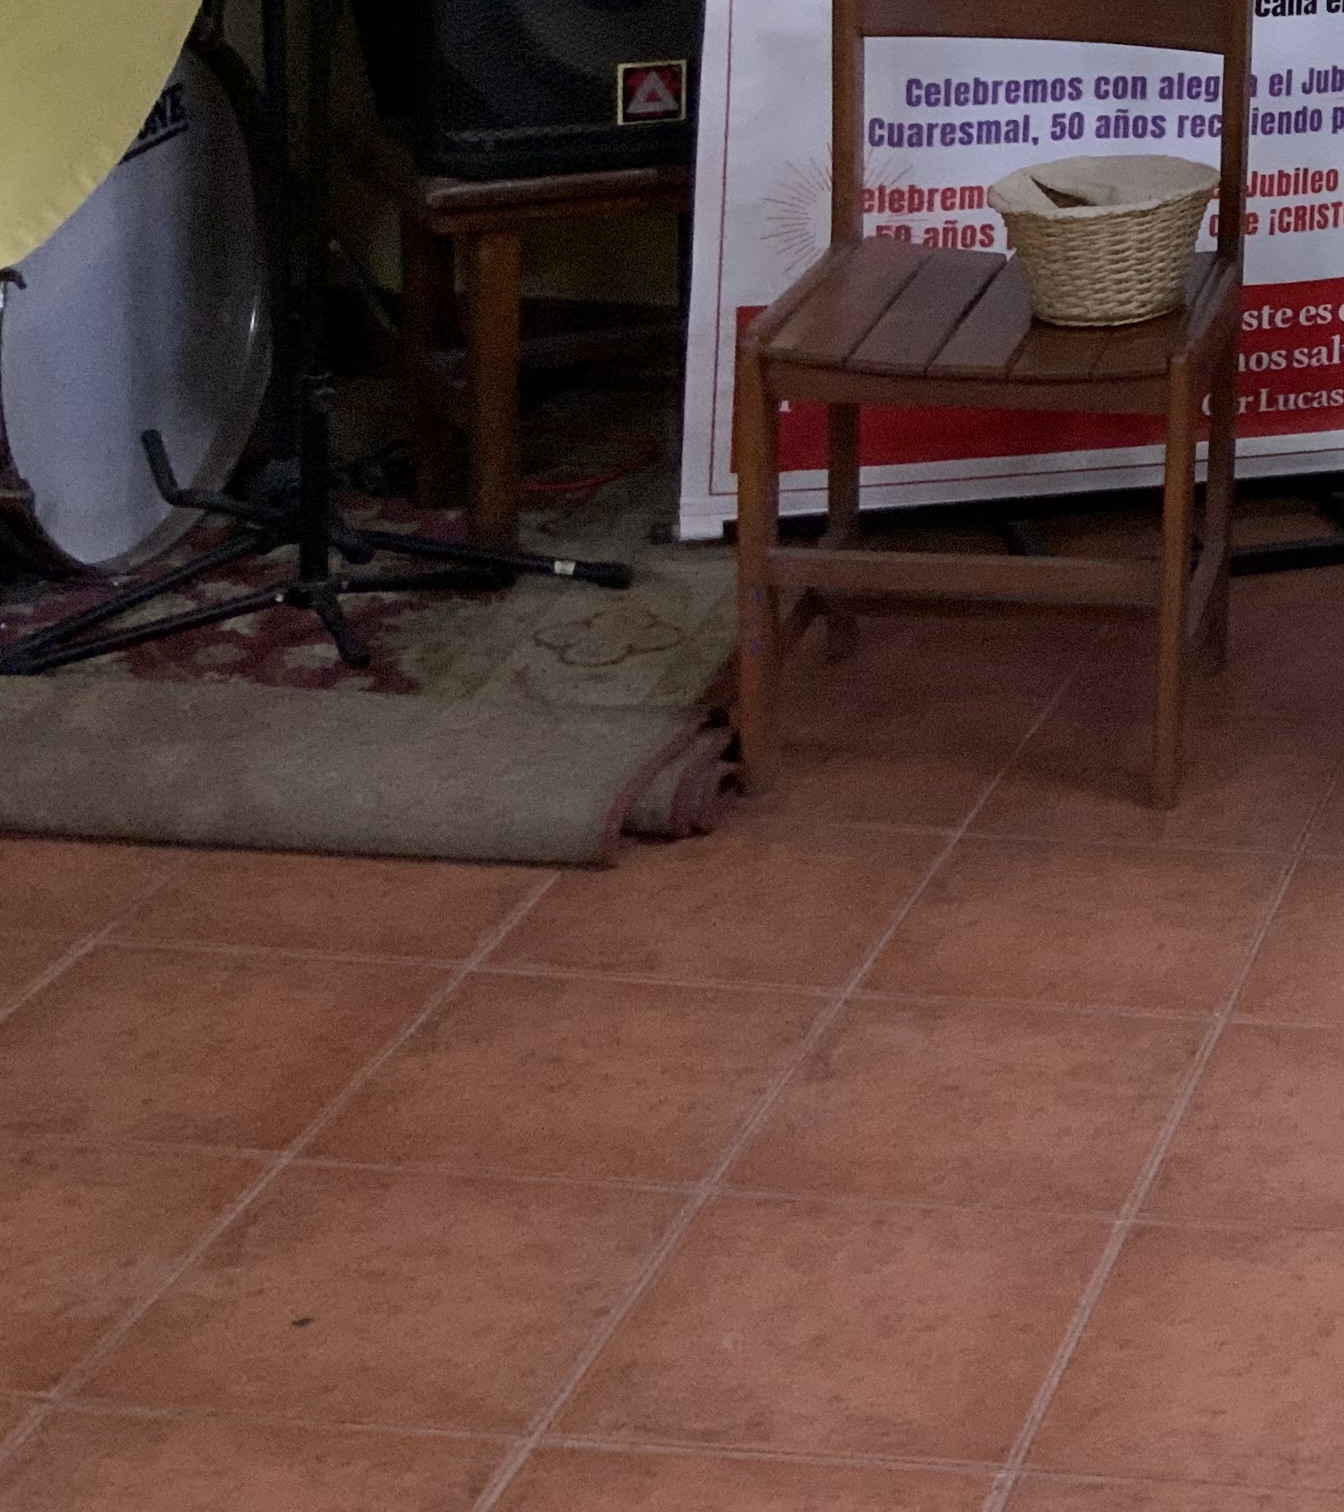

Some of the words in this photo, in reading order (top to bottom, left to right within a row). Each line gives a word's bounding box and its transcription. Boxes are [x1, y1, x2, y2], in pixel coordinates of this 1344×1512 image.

[905, 75, 1083, 107] Celebremos
[1094, 75, 1147, 100] con
[1158, 72, 1258, 103] alega
[1268, 69, 1293, 98] el
[868, 114, 1040, 149] Cuaresmal,
[1050, 112, 1085, 142] 50
[1095, 108, 1166, 140] años
[1177, 105, 1323, 140] reciendo
[1244, 167, 1339, 198] Jubileo
[923, 219, 996, 249] años
[1241, 302, 1293, 331] ste
[1299, 302, 1333, 326] es
[1258, 387, 1344, 413] Lucas
